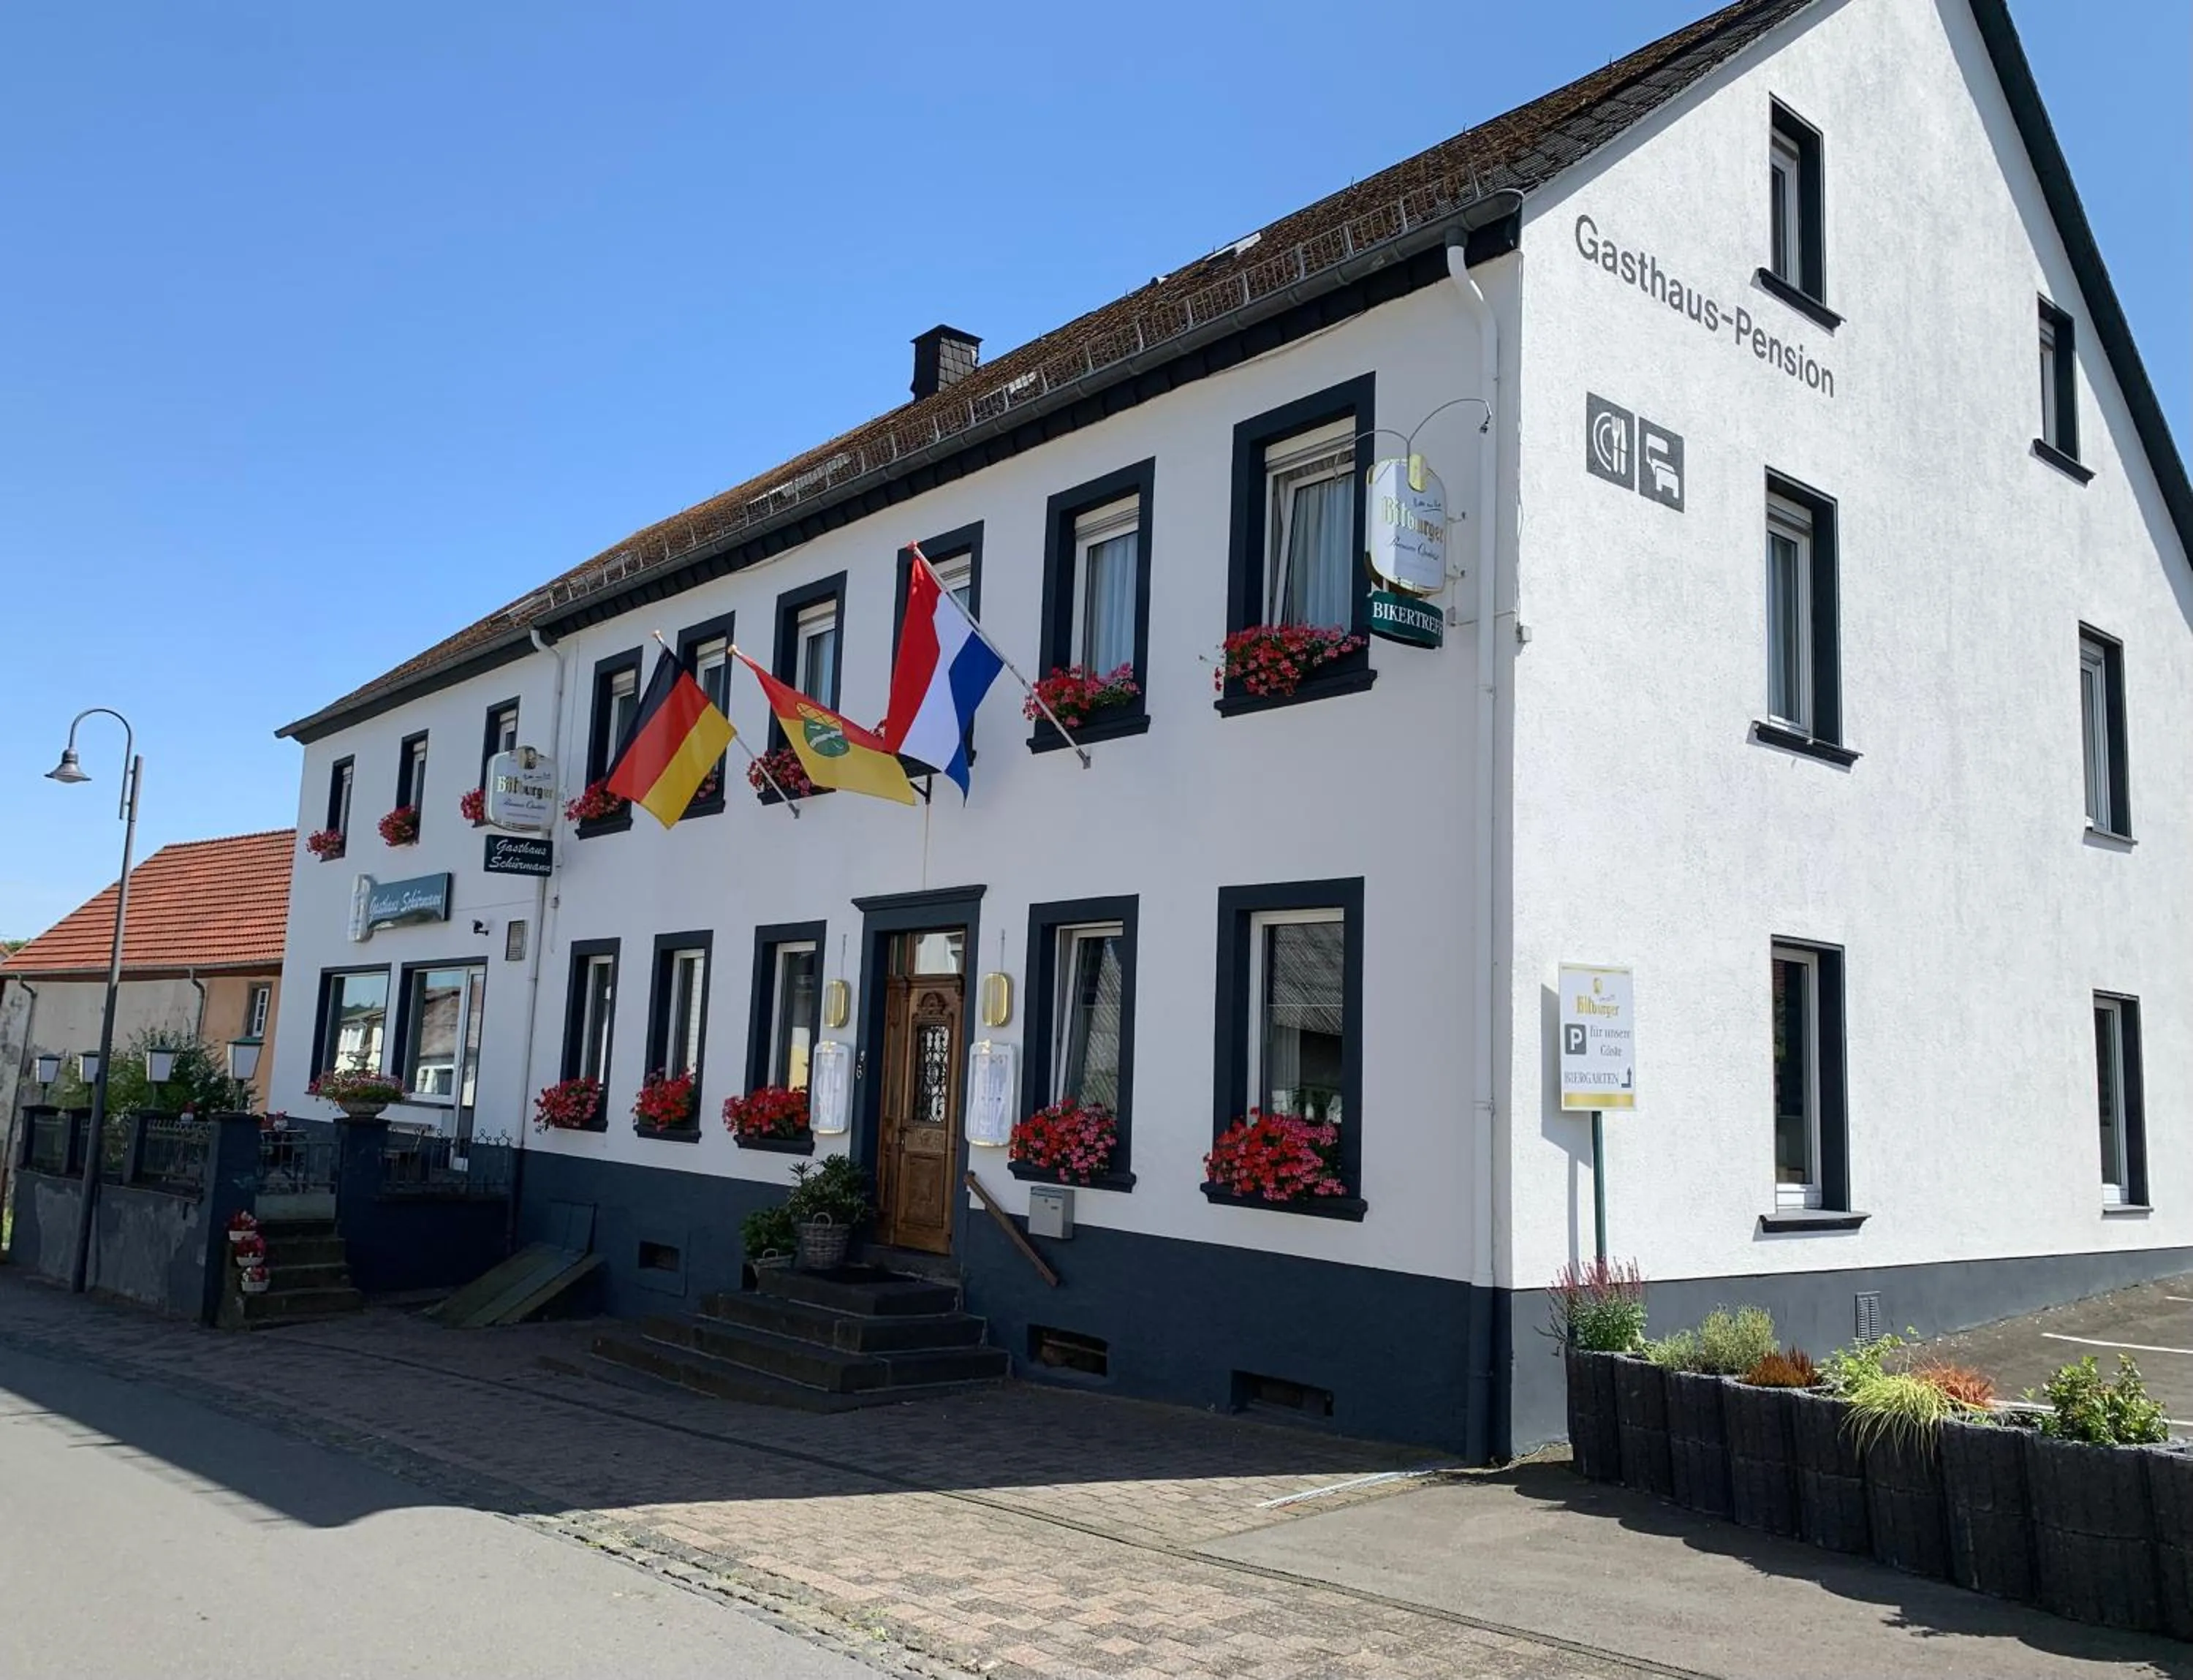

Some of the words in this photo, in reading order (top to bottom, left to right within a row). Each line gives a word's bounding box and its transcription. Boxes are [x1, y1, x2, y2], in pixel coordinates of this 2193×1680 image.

[1575, 214, 1834, 398] Gasthaus-Pension
[1382, 496, 1444, 544] Bitburger
[496, 839, 547, 856] Gasthaus
[1570, 1028, 1583, 1051] P
